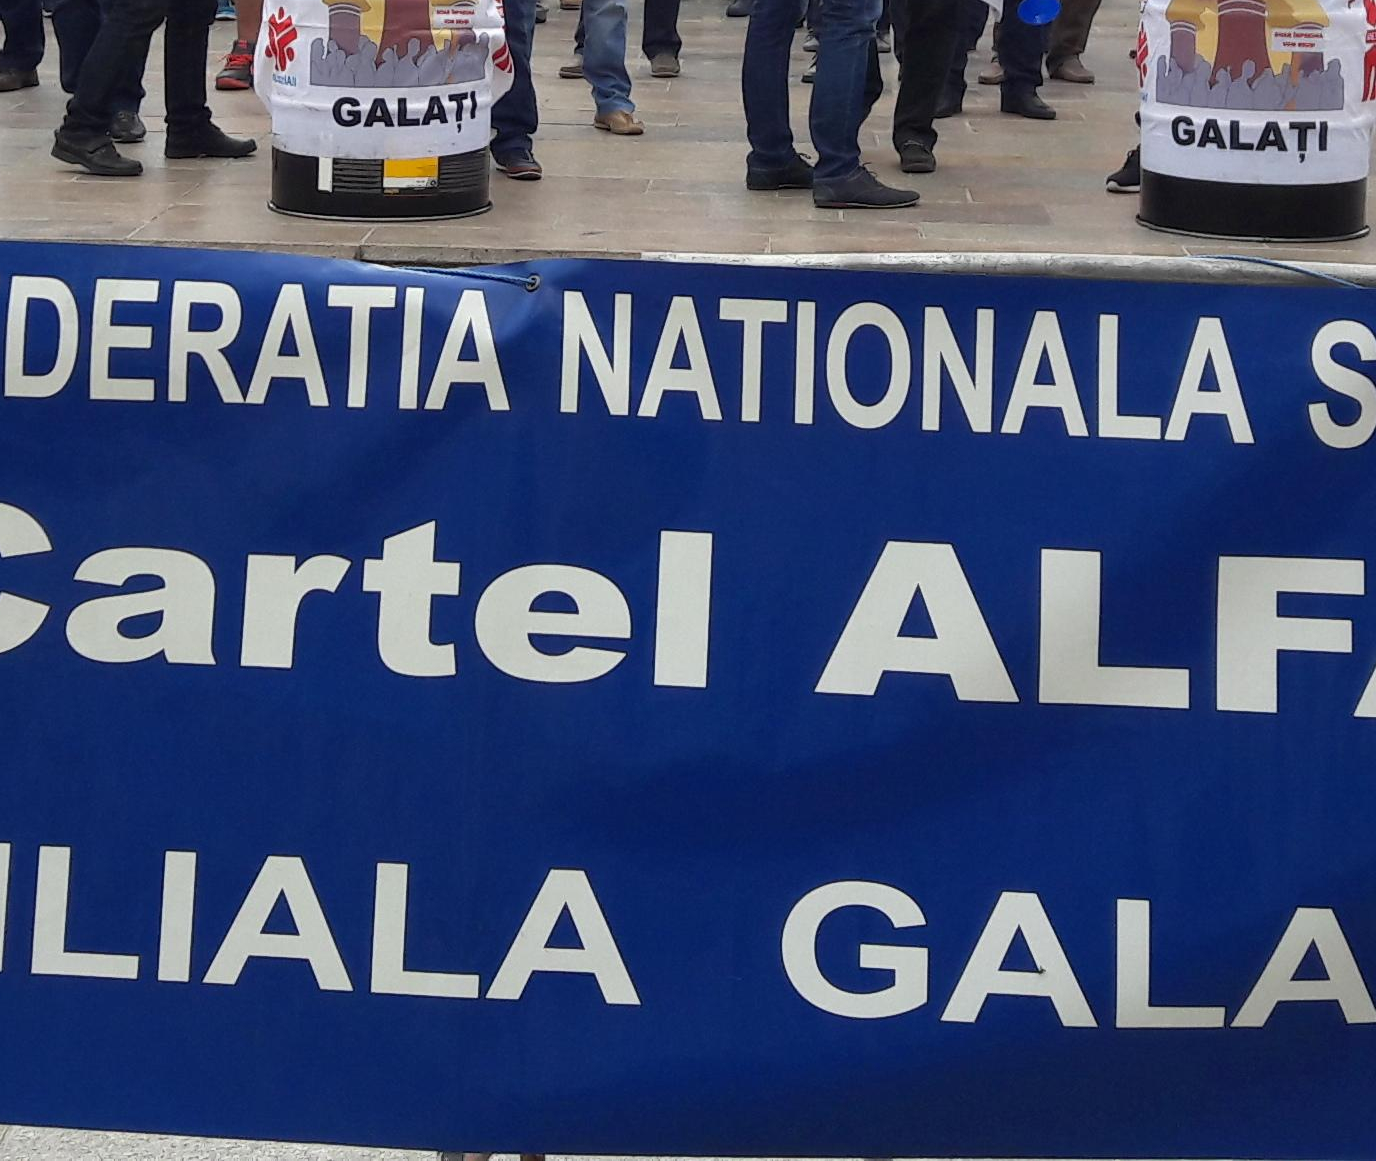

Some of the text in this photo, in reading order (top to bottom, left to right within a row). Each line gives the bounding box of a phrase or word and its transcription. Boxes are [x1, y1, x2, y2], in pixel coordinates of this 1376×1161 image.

[332, 91, 478, 133] GALAȚI
[1171, 115, 1329, 163] GALAȚI
[561, 291, 1253, 444] NATIONALA
